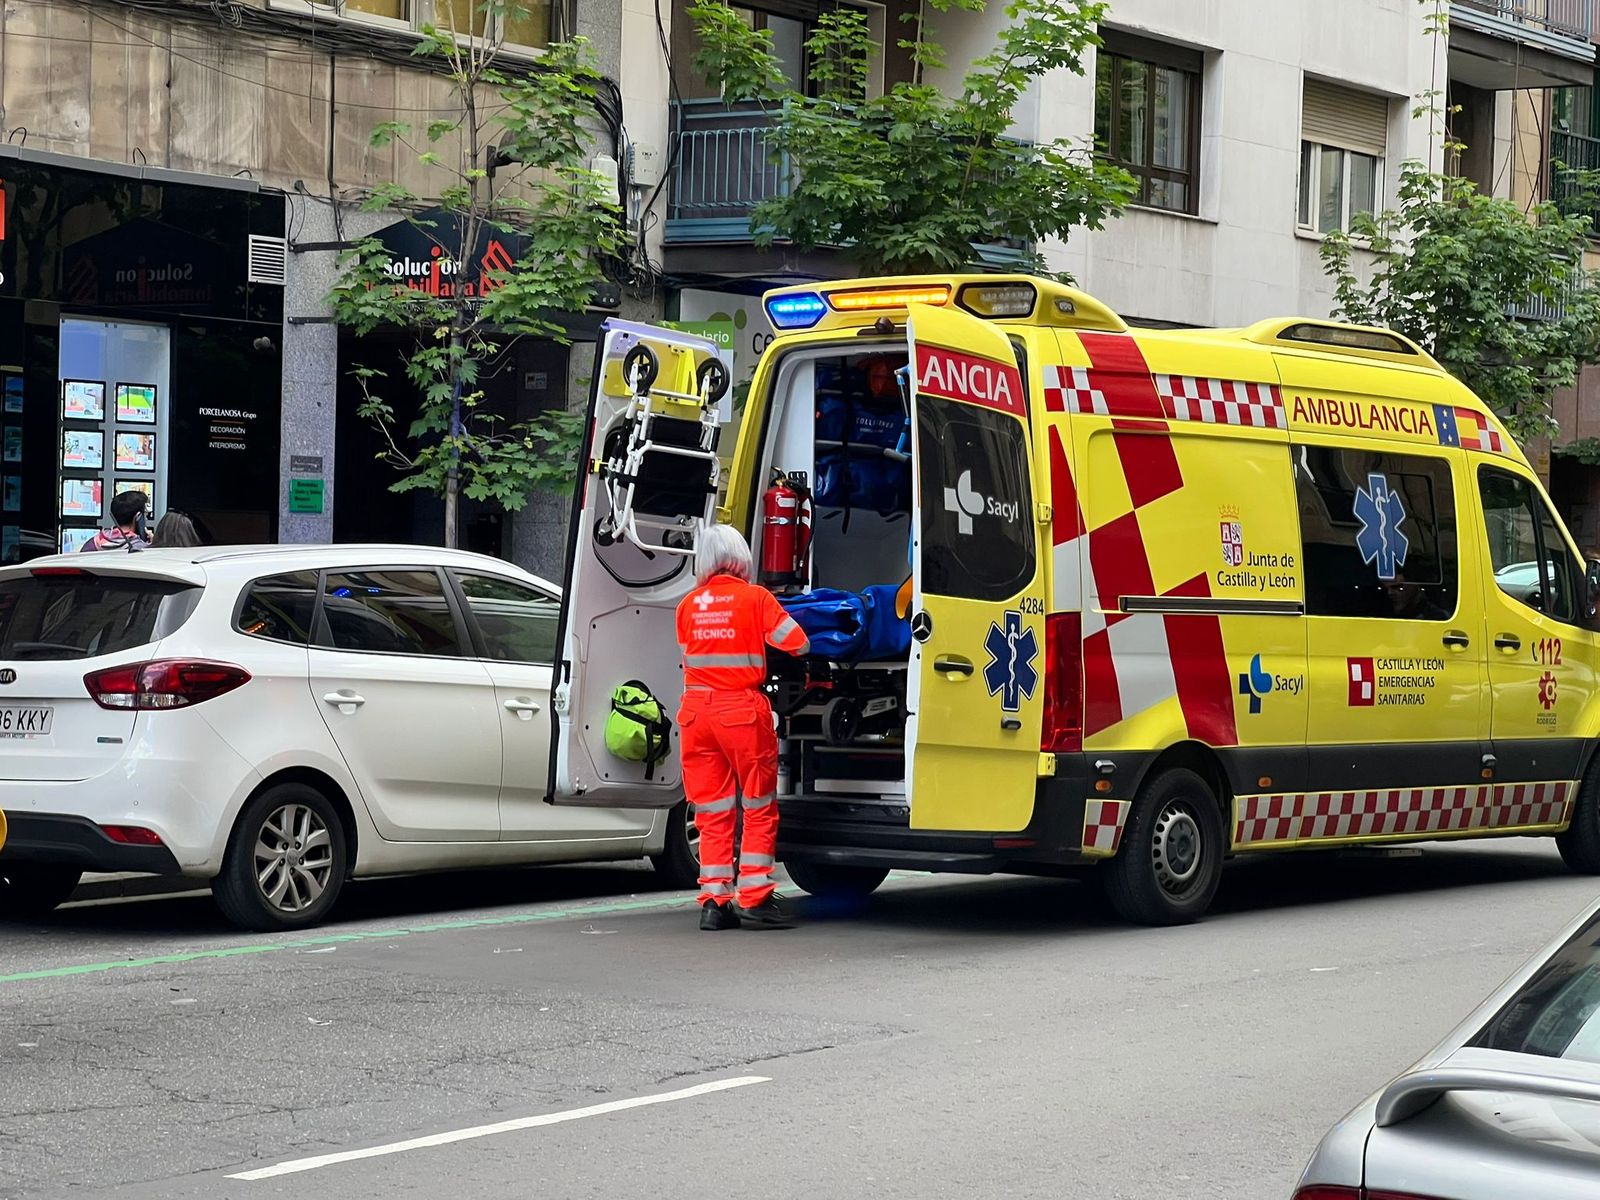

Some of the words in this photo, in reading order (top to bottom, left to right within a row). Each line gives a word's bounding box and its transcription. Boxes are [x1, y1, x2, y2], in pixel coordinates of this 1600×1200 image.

[917, 355, 1013, 406] ANCIA
[199, 407, 241, 417] PORCELANOSA
[1293, 396, 1434, 436] AMBULANCIA
[987, 496, 1019, 523] Sacyl
[1247, 551, 1278, 567] Junta
[1280, 553, 1294, 568] de
[1217, 571, 1257, 587] Castilla
[1259, 575, 1266, 592] y
[1269, 572, 1296, 588] León
[1019, 597, 1045, 615] 4284
[1539, 638, 1562, 666] 112
[1377, 658, 1415, 670] CASTILLA
[1415, 659, 1422, 670] Y
[1422, 656, 1445, 670] LEÓN
[1274, 674, 1304, 696] Sacyl
[1378, 676, 1435, 688] EMERGENCIAS
[1378, 693, 1425, 705] SANITARIAS
[16, 710, 49, 731] KKY
